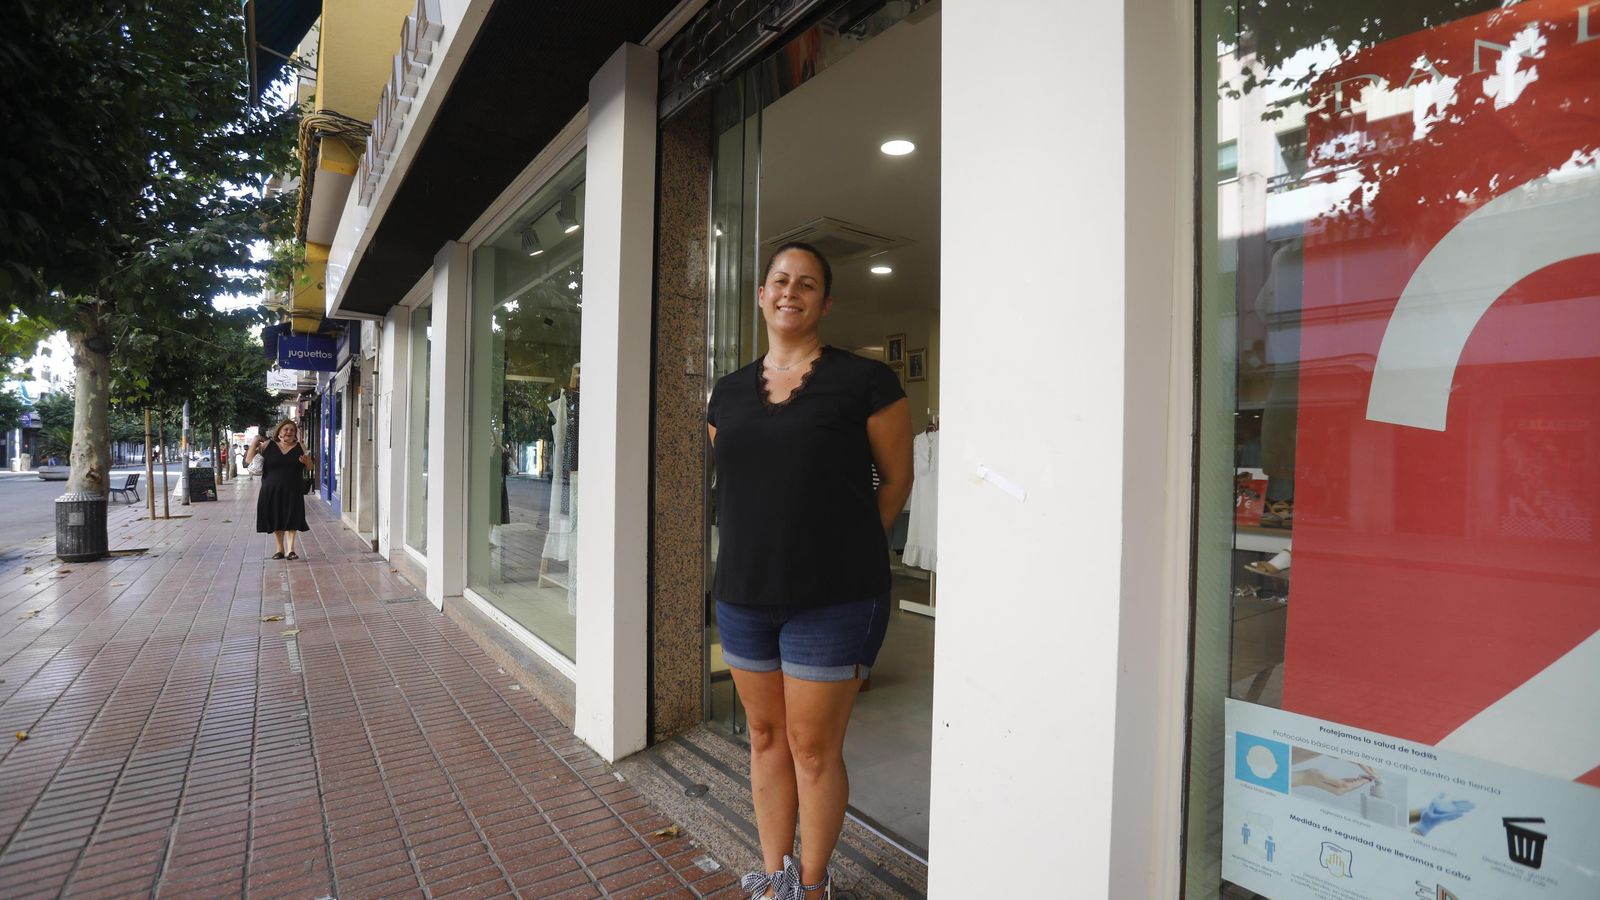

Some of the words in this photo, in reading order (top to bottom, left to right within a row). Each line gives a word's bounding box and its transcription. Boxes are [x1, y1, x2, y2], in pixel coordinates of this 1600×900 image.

[288, 349, 333, 359] juguettos
[1272, 729, 1310, 745] Protocolos
[1341, 747, 1360, 758] para
[1361, 751, 1385, 765] llevar
[1393, 761, 1417, 774] cabo
[1419, 767, 1450, 782] dentro
[1452, 775, 1466, 786] de
[1468, 780, 1501, 796] tienda
[1319, 725, 1361, 742] Protejamos
[1363, 736, 1372, 744] la
[1373, 739, 1396, 751] salud
[1397, 746, 1410, 754] de
[1289, 813, 1321, 830] Medidas
[1322, 824, 1333, 834] de
[1334, 830, 1374, 847] seguridad
[1376, 843, 1392, 854] que
[1394, 848, 1434, 869] llevamos
[1436, 864, 1443, 872] a
[1445, 866, 1471, 882] cabo
